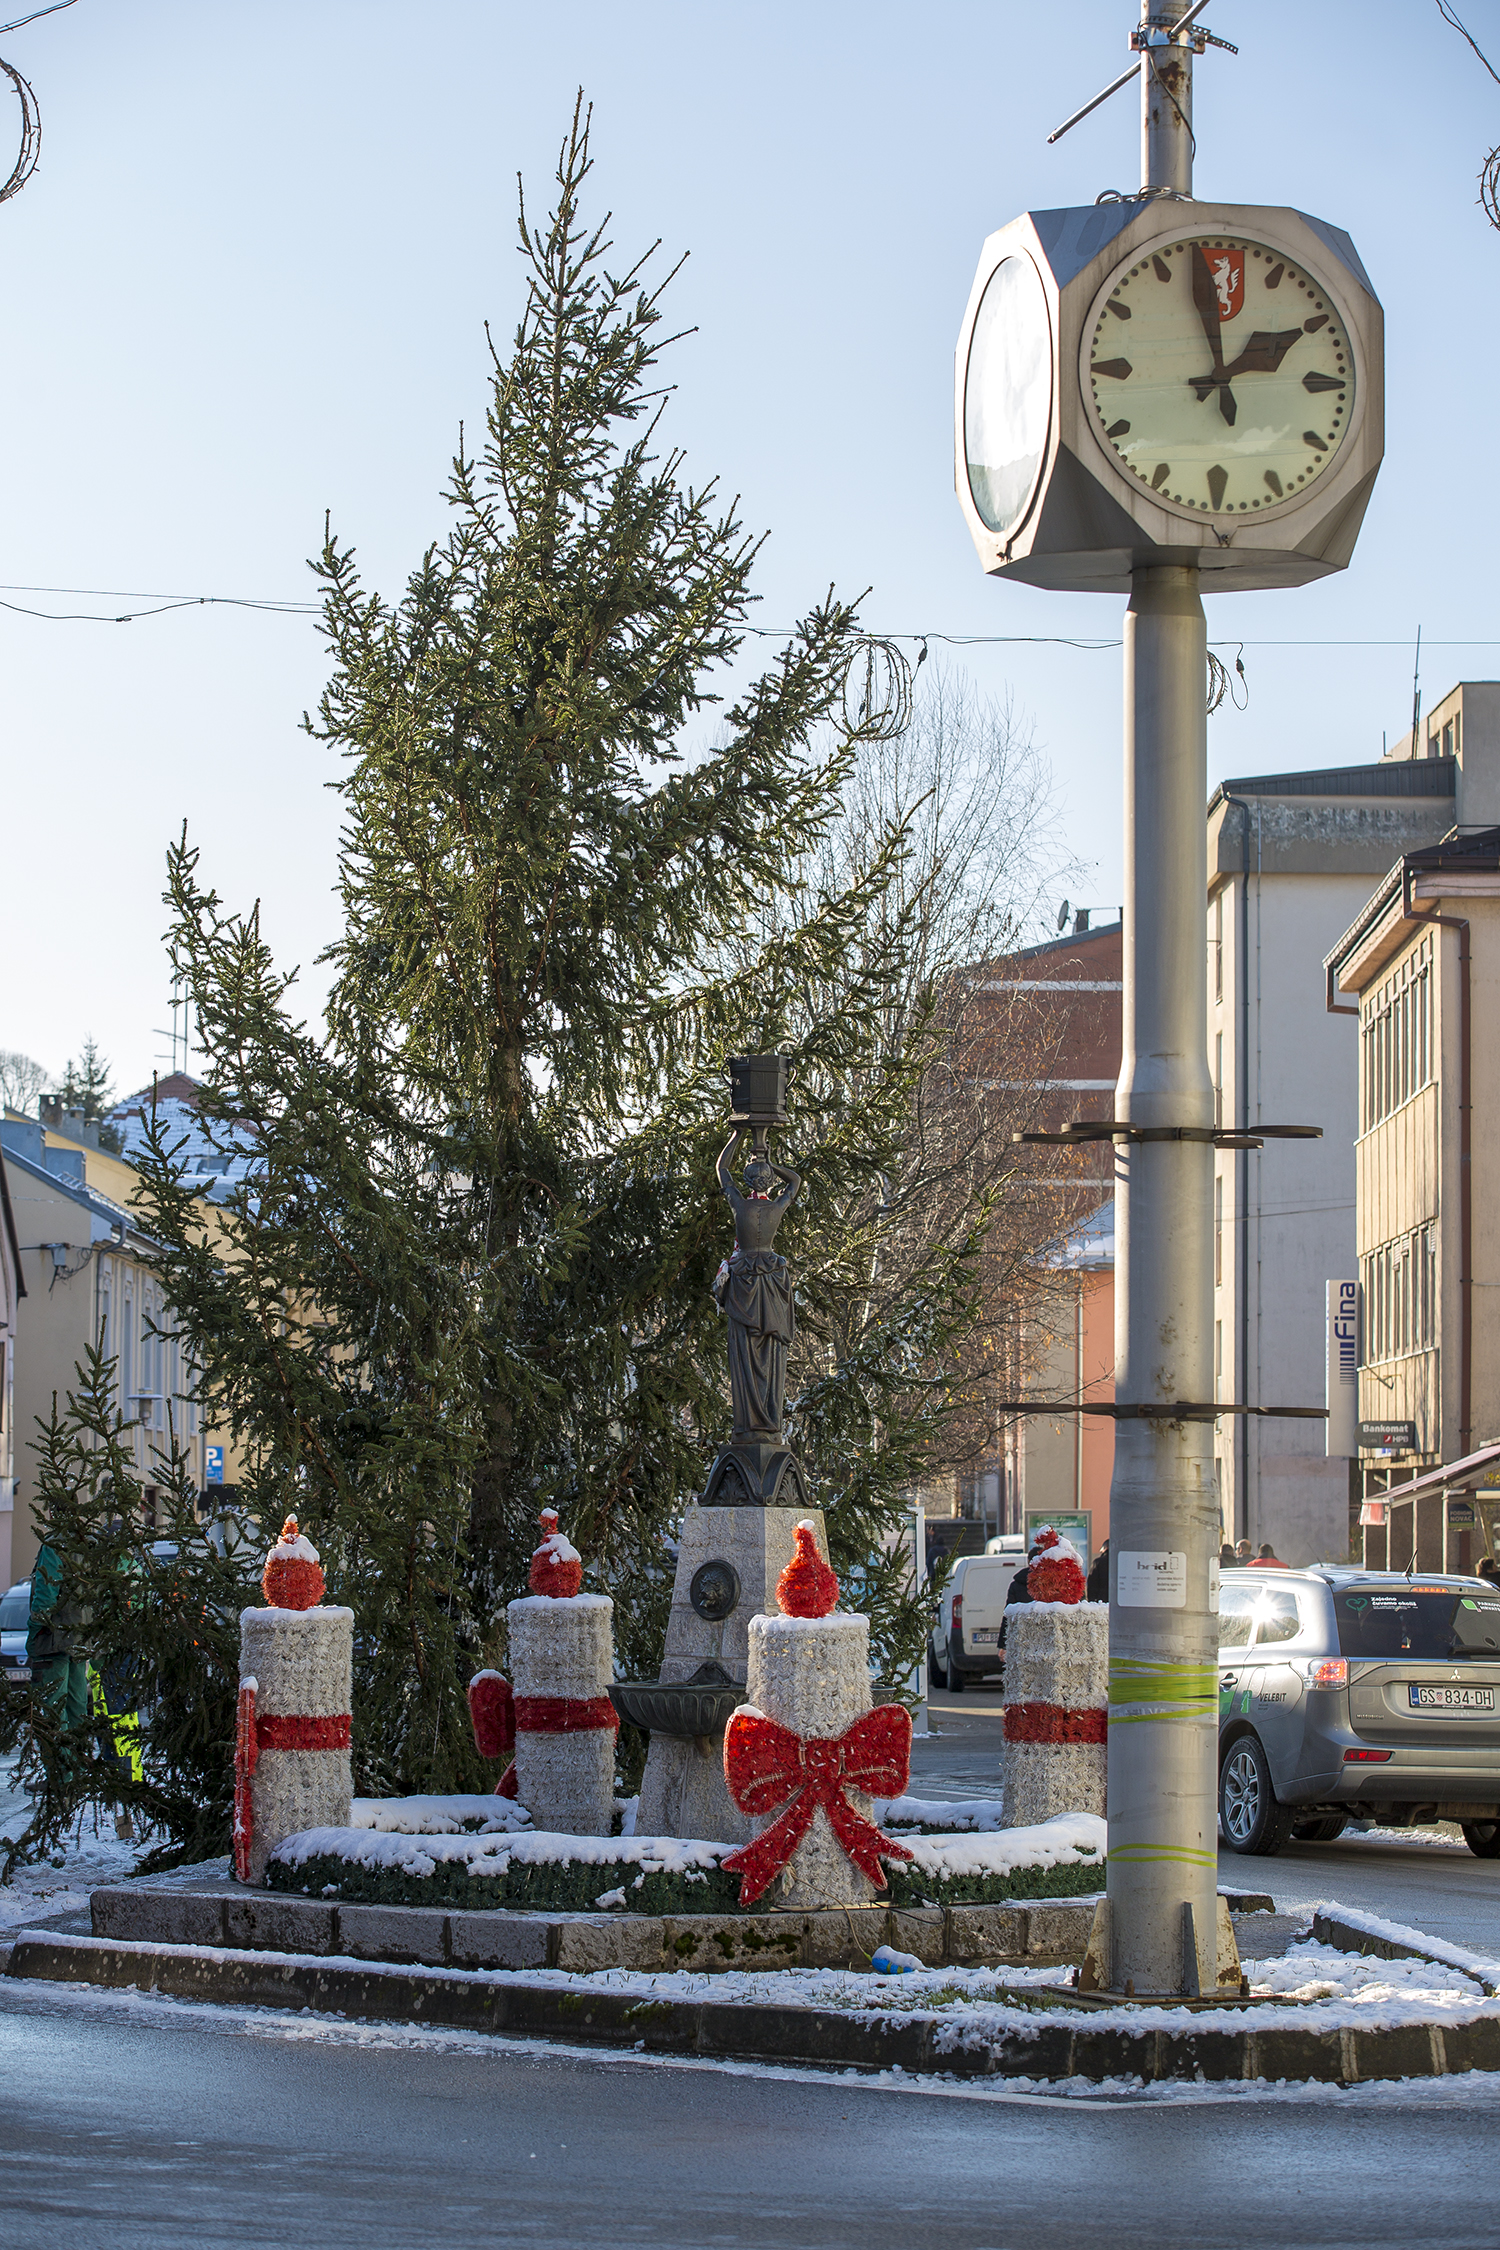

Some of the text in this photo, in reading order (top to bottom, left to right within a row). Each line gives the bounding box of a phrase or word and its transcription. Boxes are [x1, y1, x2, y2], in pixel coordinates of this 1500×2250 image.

[1334, 1282, 1356, 1340] Fina
[1362, 1424, 1409, 1433] Bankomat
[1392, 1435, 1409, 1443] HPB
[206, 1448, 218, 1466] P
[1259, 1692, 1287, 1702] VELEBIT
[1419, 1688, 1491, 1705] GS 834-DH
